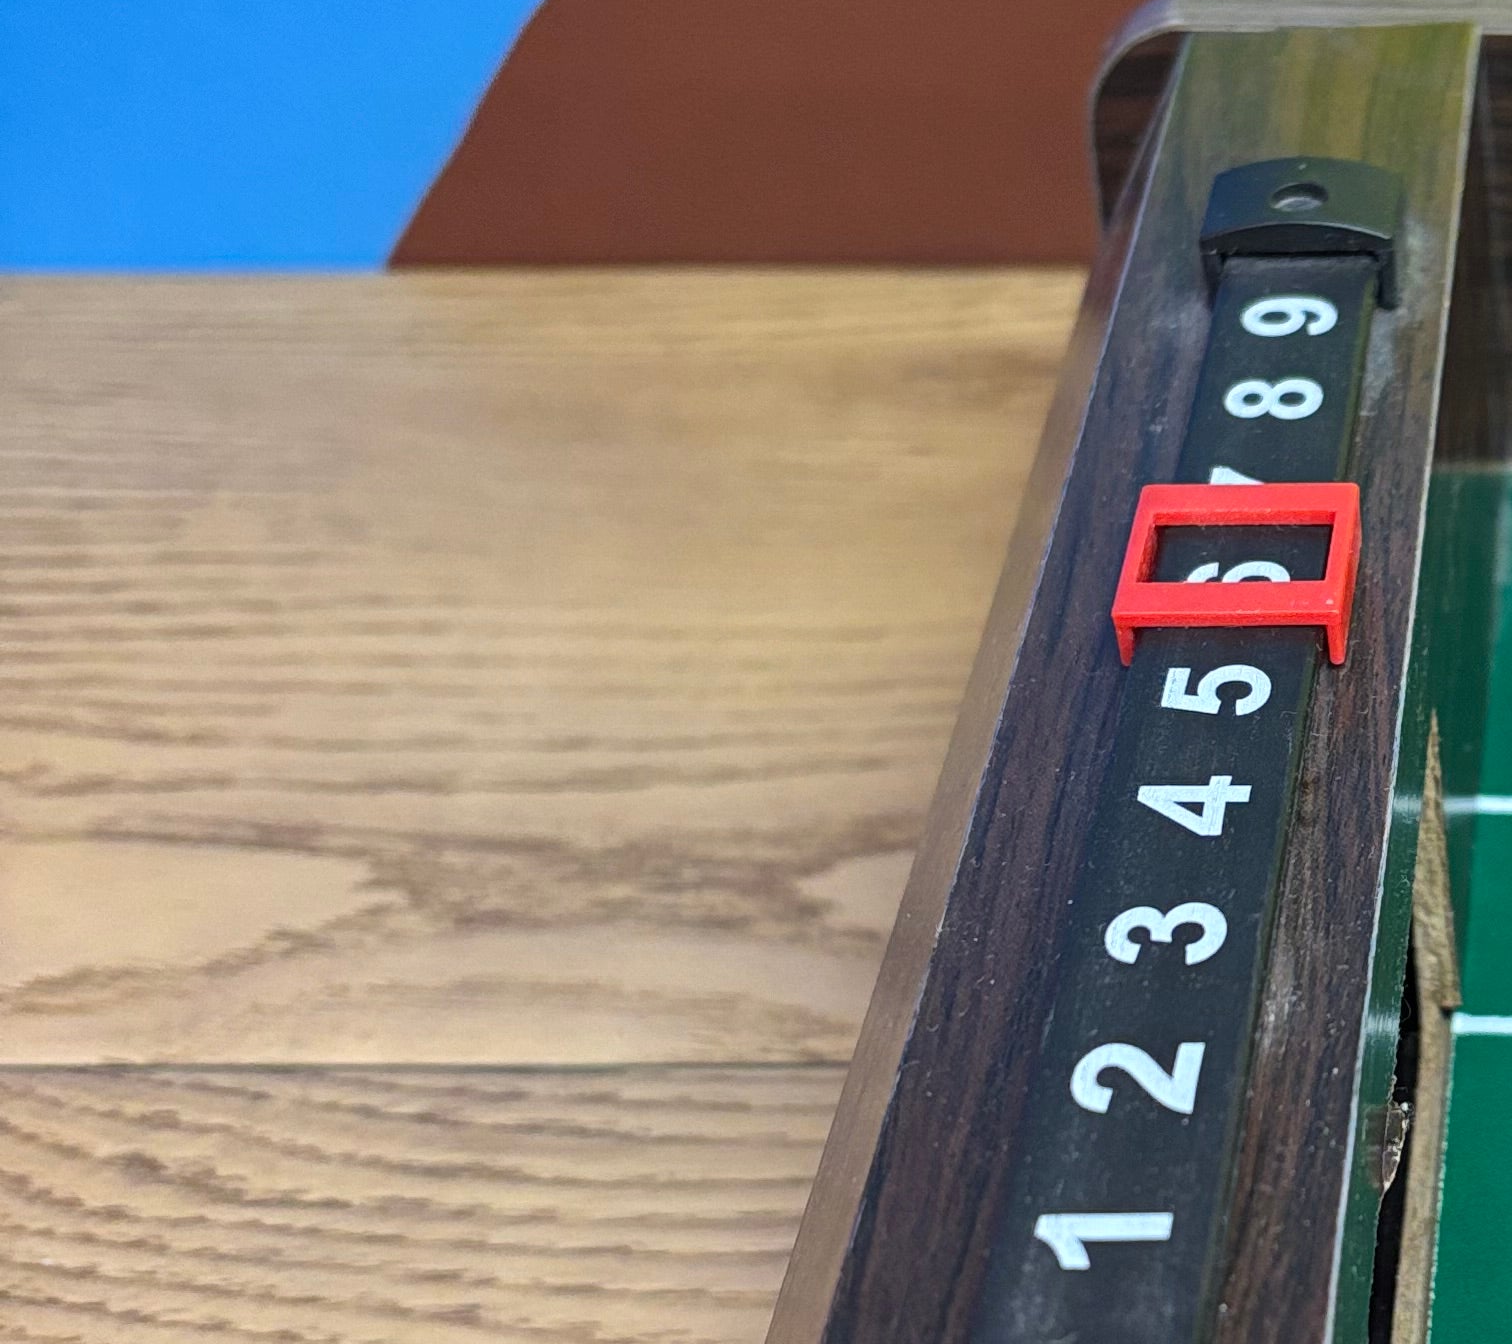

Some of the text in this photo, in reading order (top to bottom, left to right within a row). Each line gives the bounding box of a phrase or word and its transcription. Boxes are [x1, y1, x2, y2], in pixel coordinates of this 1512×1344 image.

[1240, 294, 1339, 338] 9
[1222, 376, 1324, 421] 8
[1159, 663, 1272, 717] 5
[1136, 774, 1253, 837] 4
[1103, 901, 1228, 966] 3
[1069, 1041, 1206, 1115] 2
[1033, 1211, 1175, 1271] 1
